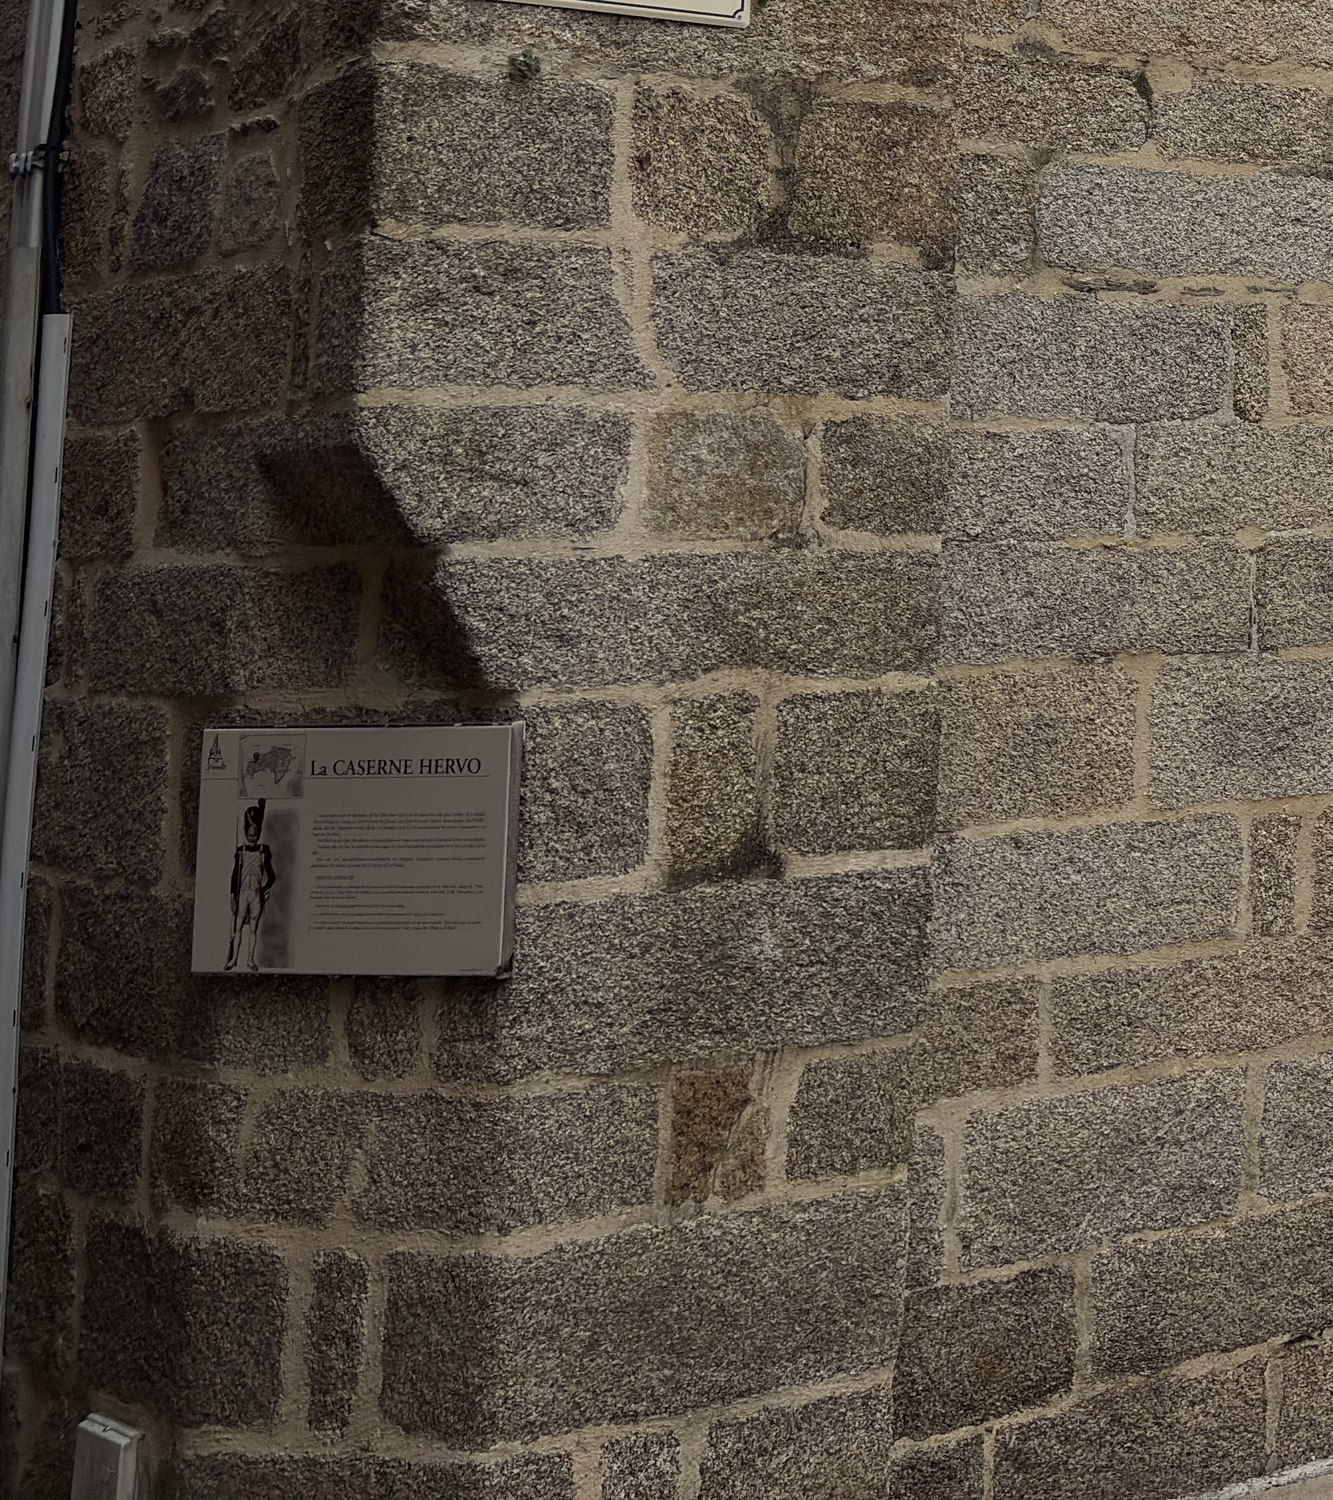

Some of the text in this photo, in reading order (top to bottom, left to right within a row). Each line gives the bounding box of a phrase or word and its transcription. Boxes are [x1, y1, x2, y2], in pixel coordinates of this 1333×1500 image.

[310, 757, 482, 777] La CASERNE HERVO
